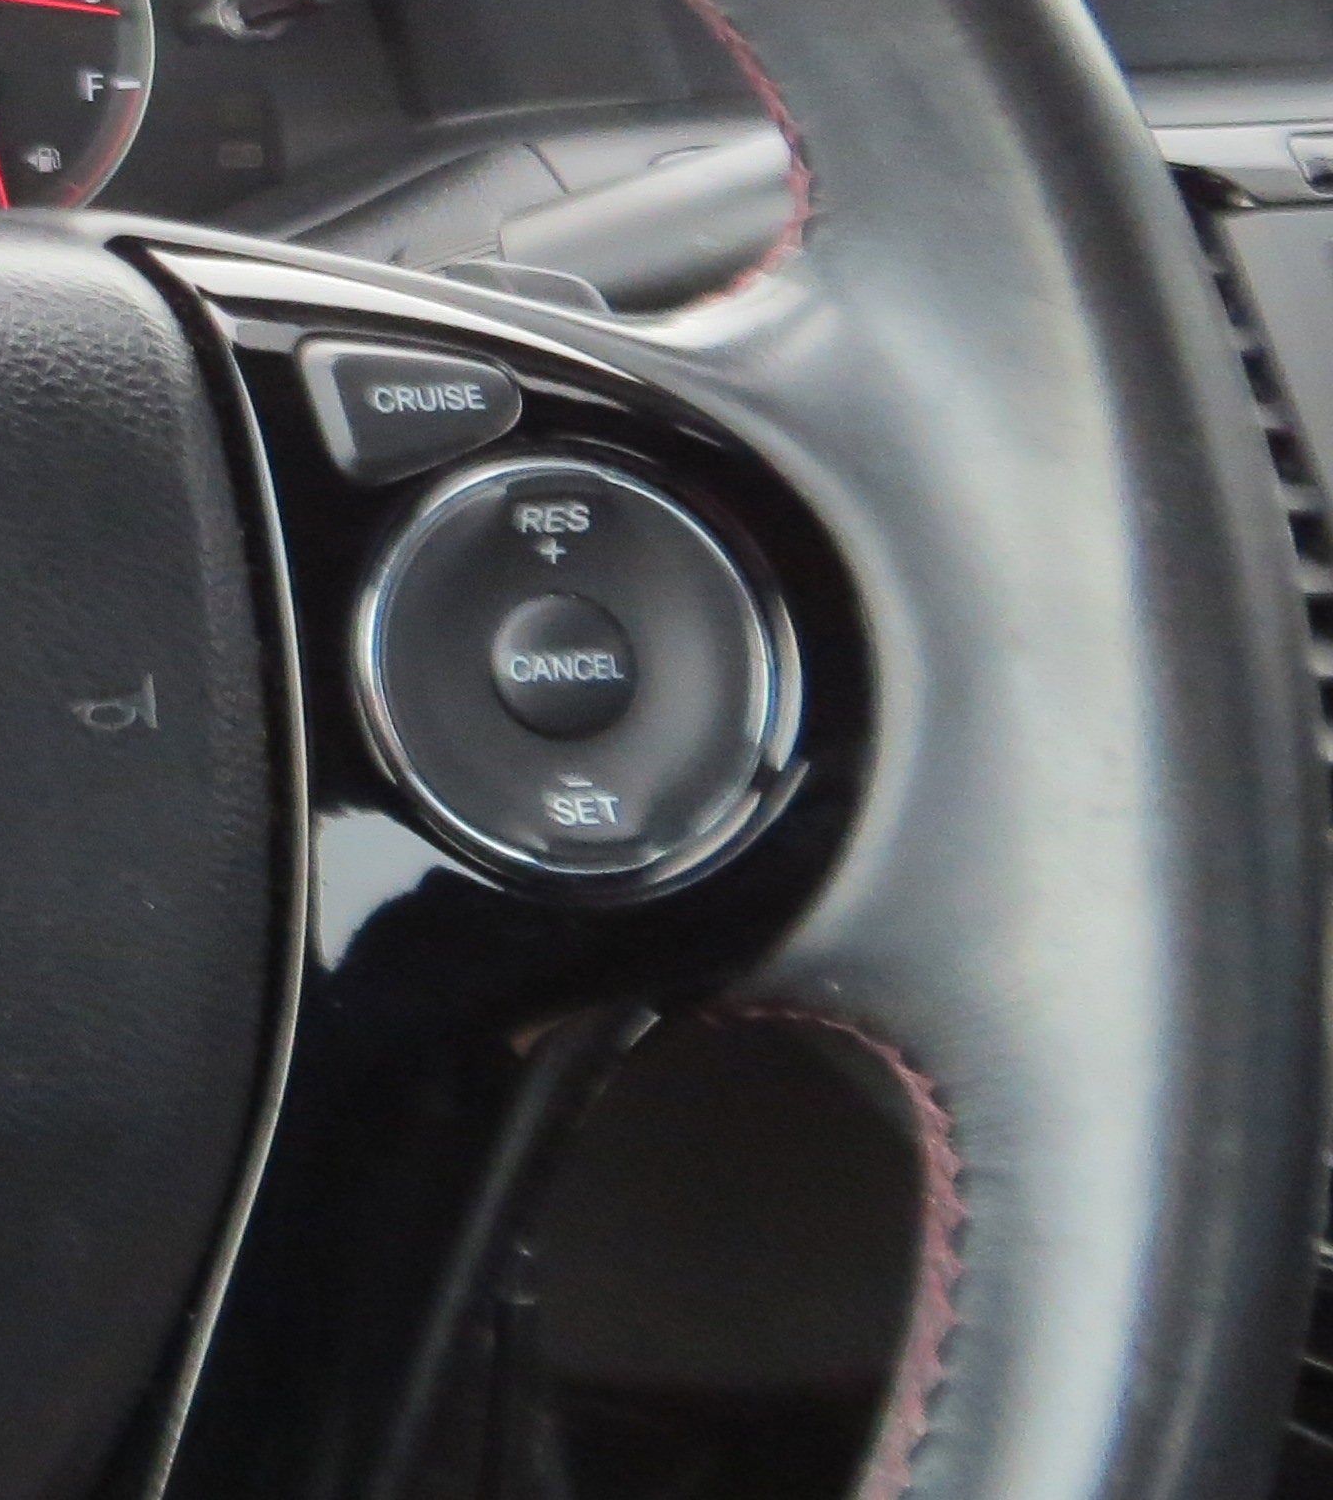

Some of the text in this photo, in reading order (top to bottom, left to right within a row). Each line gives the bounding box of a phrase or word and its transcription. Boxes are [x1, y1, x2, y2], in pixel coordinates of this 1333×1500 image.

[81, 72, 104, 103] F
[372, 384, 486, 415] CRUISE
[519, 504, 591, 534] RES
[509, 653, 626, 683] CANCEL
[549, 796, 621, 825] SET
